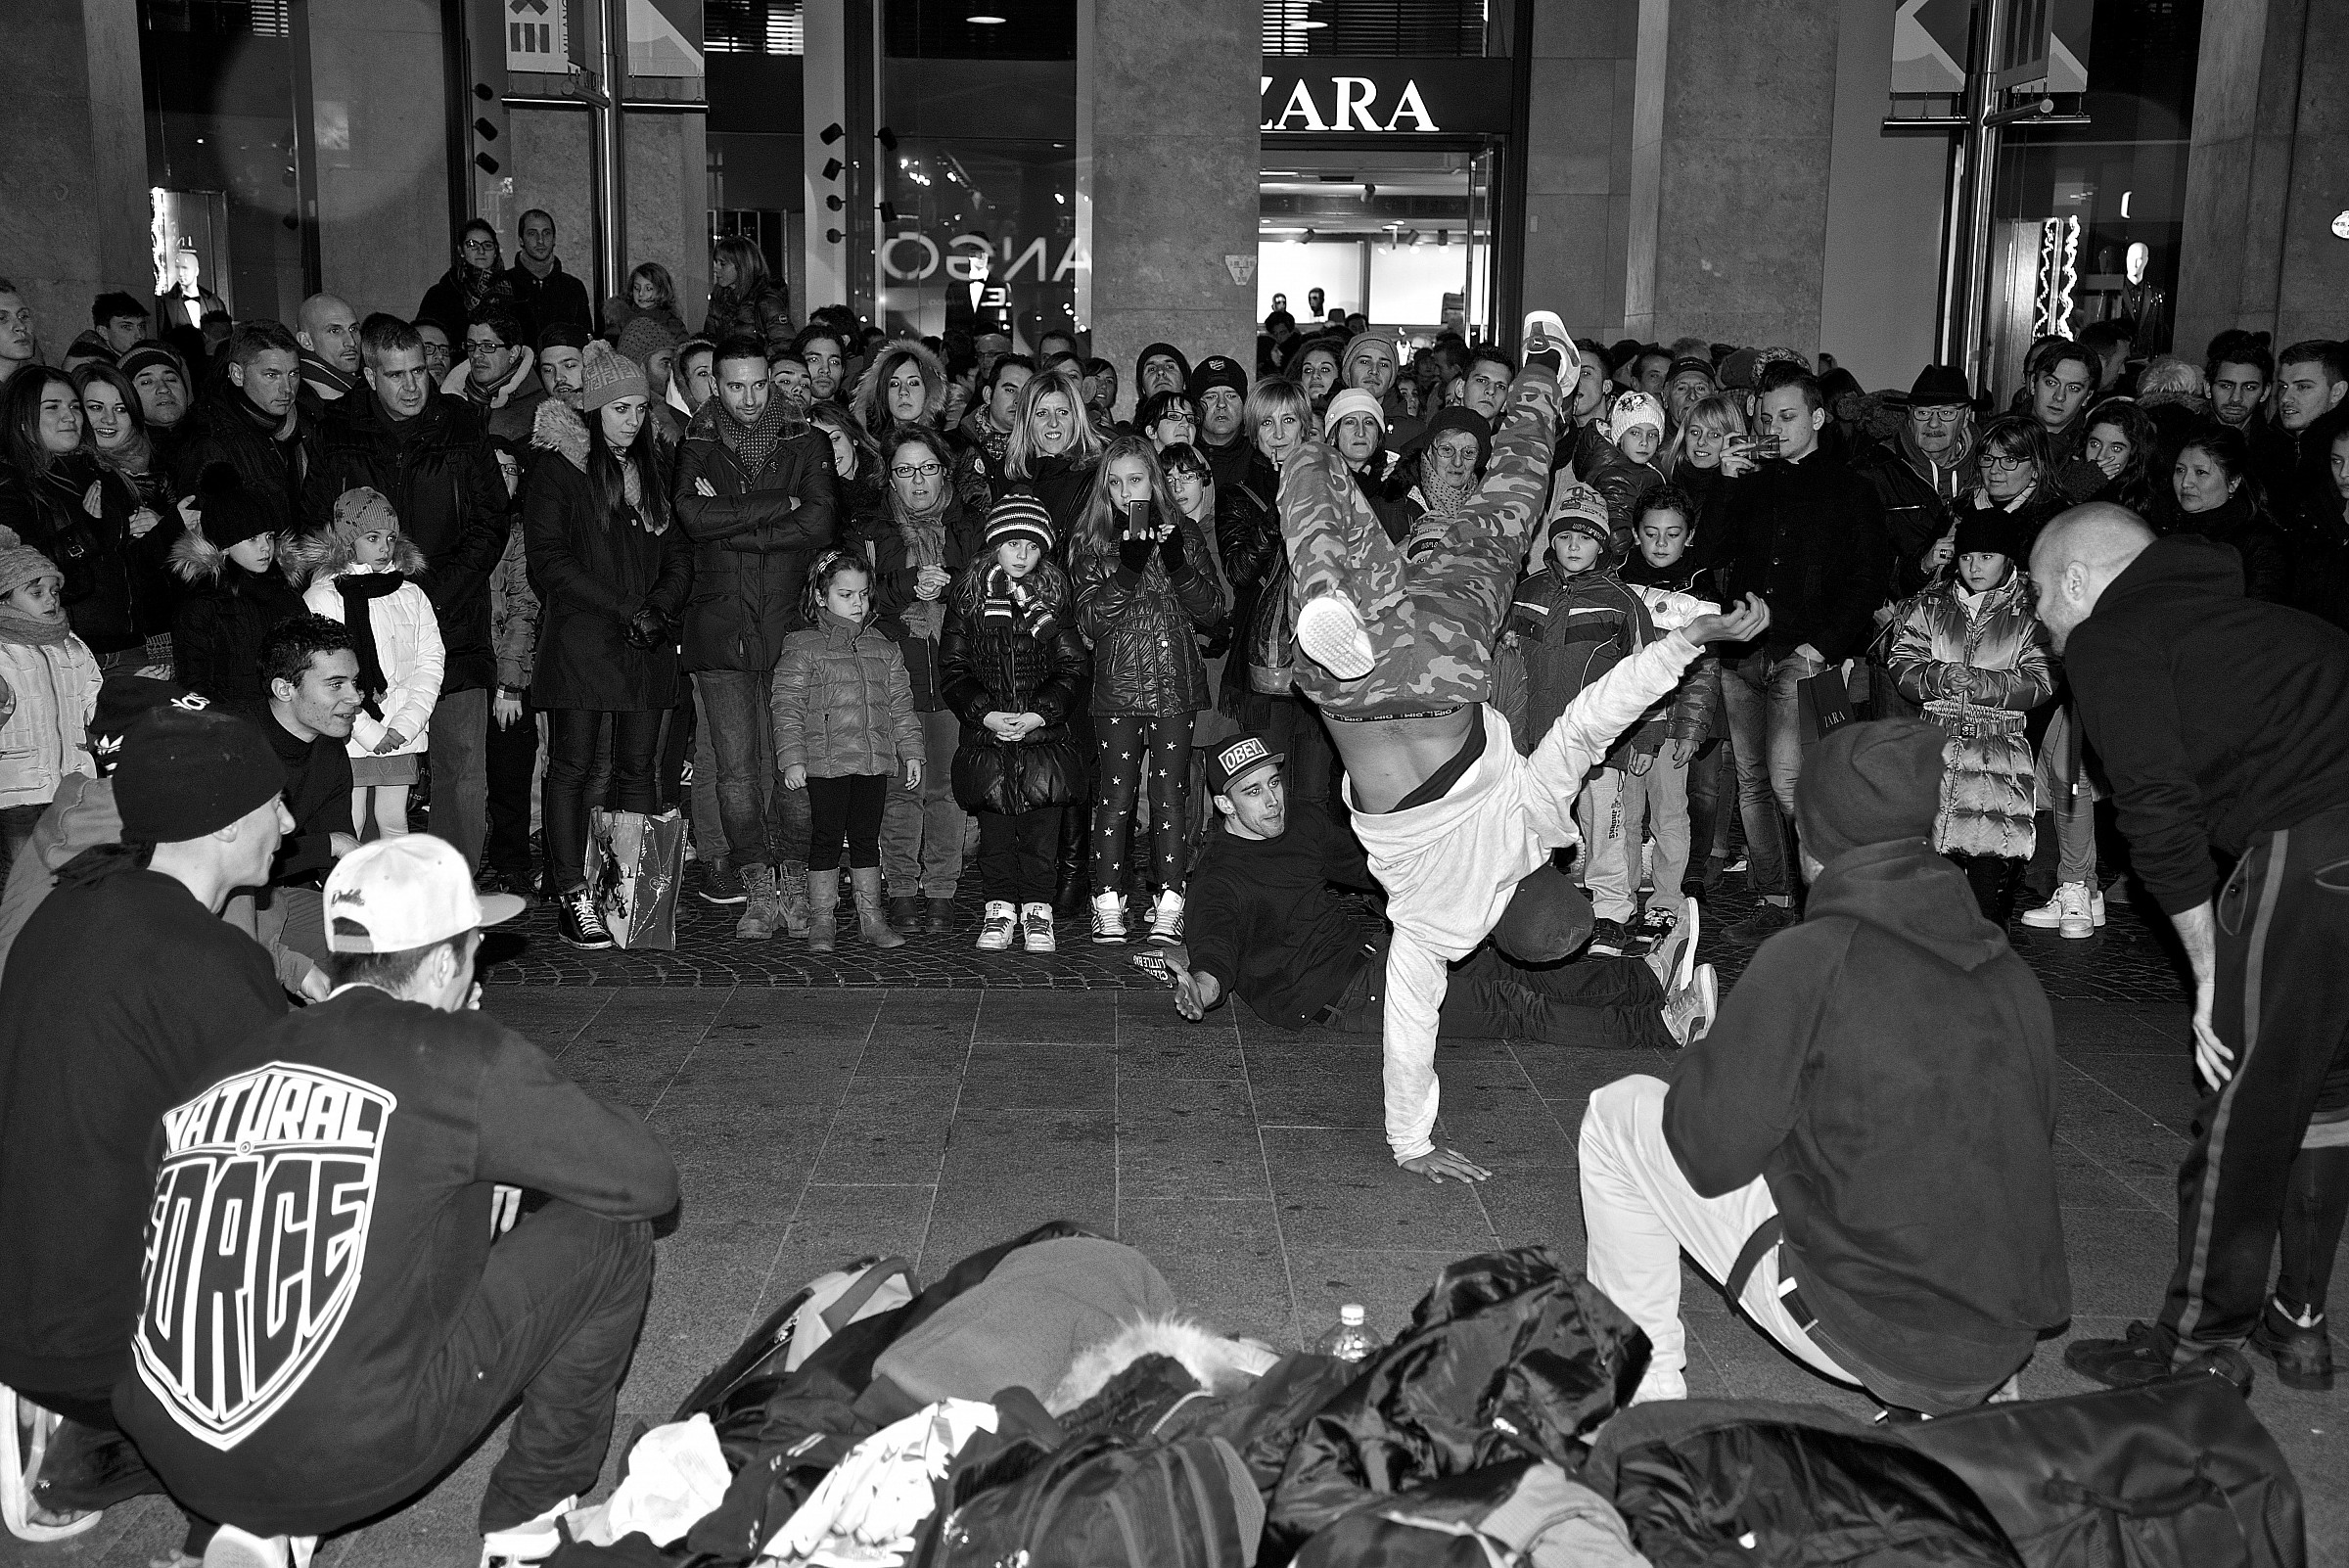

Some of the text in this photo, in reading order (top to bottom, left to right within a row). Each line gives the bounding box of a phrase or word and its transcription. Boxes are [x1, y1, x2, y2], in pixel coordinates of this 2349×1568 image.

[1823, 710, 1846, 728] ZARA
[1143, 956, 1166, 969] LITTLE
[164, 1074, 376, 1153] NATURAL
